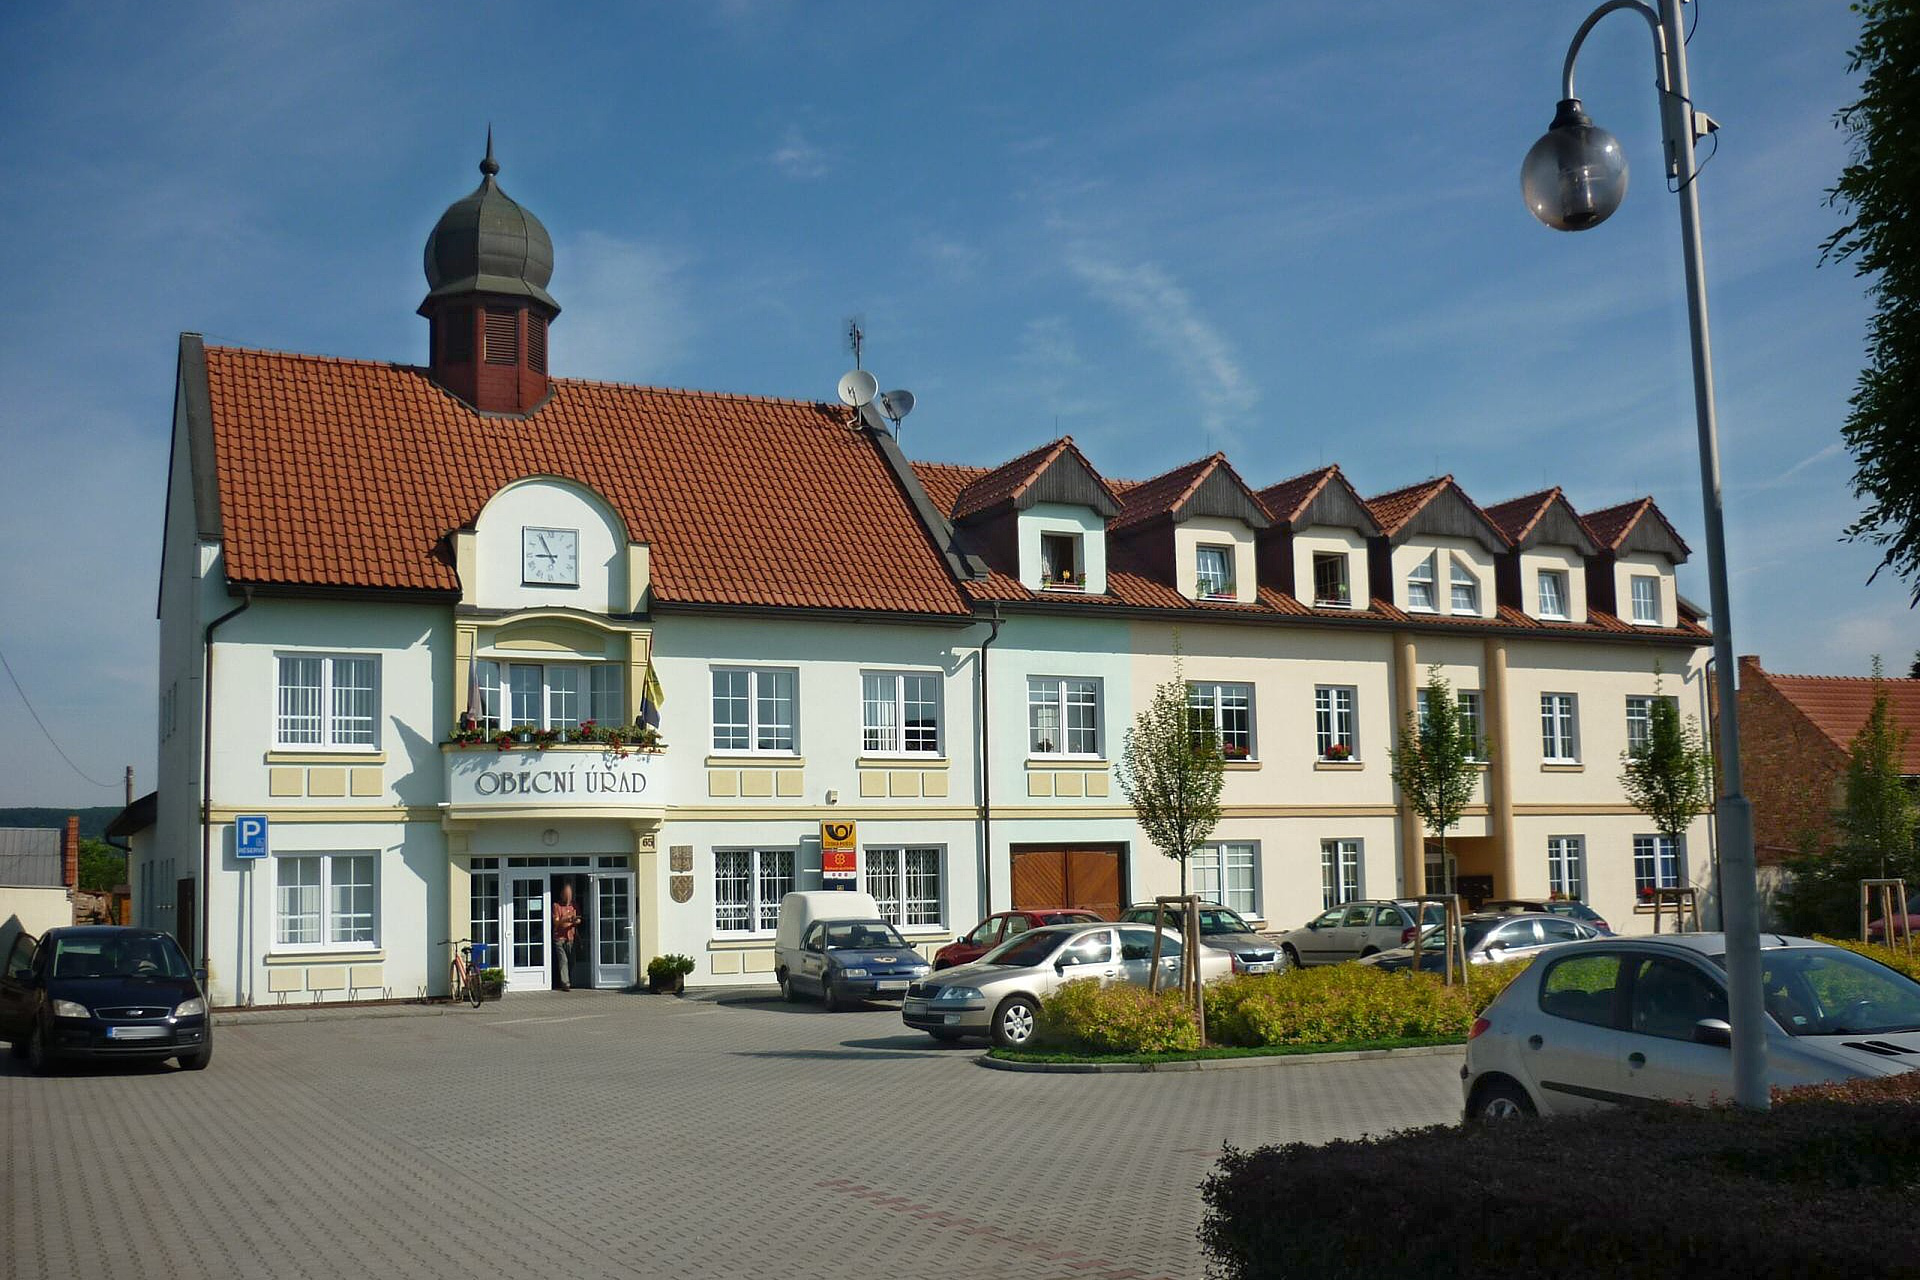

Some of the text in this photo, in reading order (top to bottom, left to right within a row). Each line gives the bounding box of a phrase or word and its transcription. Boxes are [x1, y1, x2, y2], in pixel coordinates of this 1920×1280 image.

[478, 762, 648, 796] OBECNÍ ÚŘAD
[243, 820, 261, 845] P
[643, 838, 653, 847] 65
